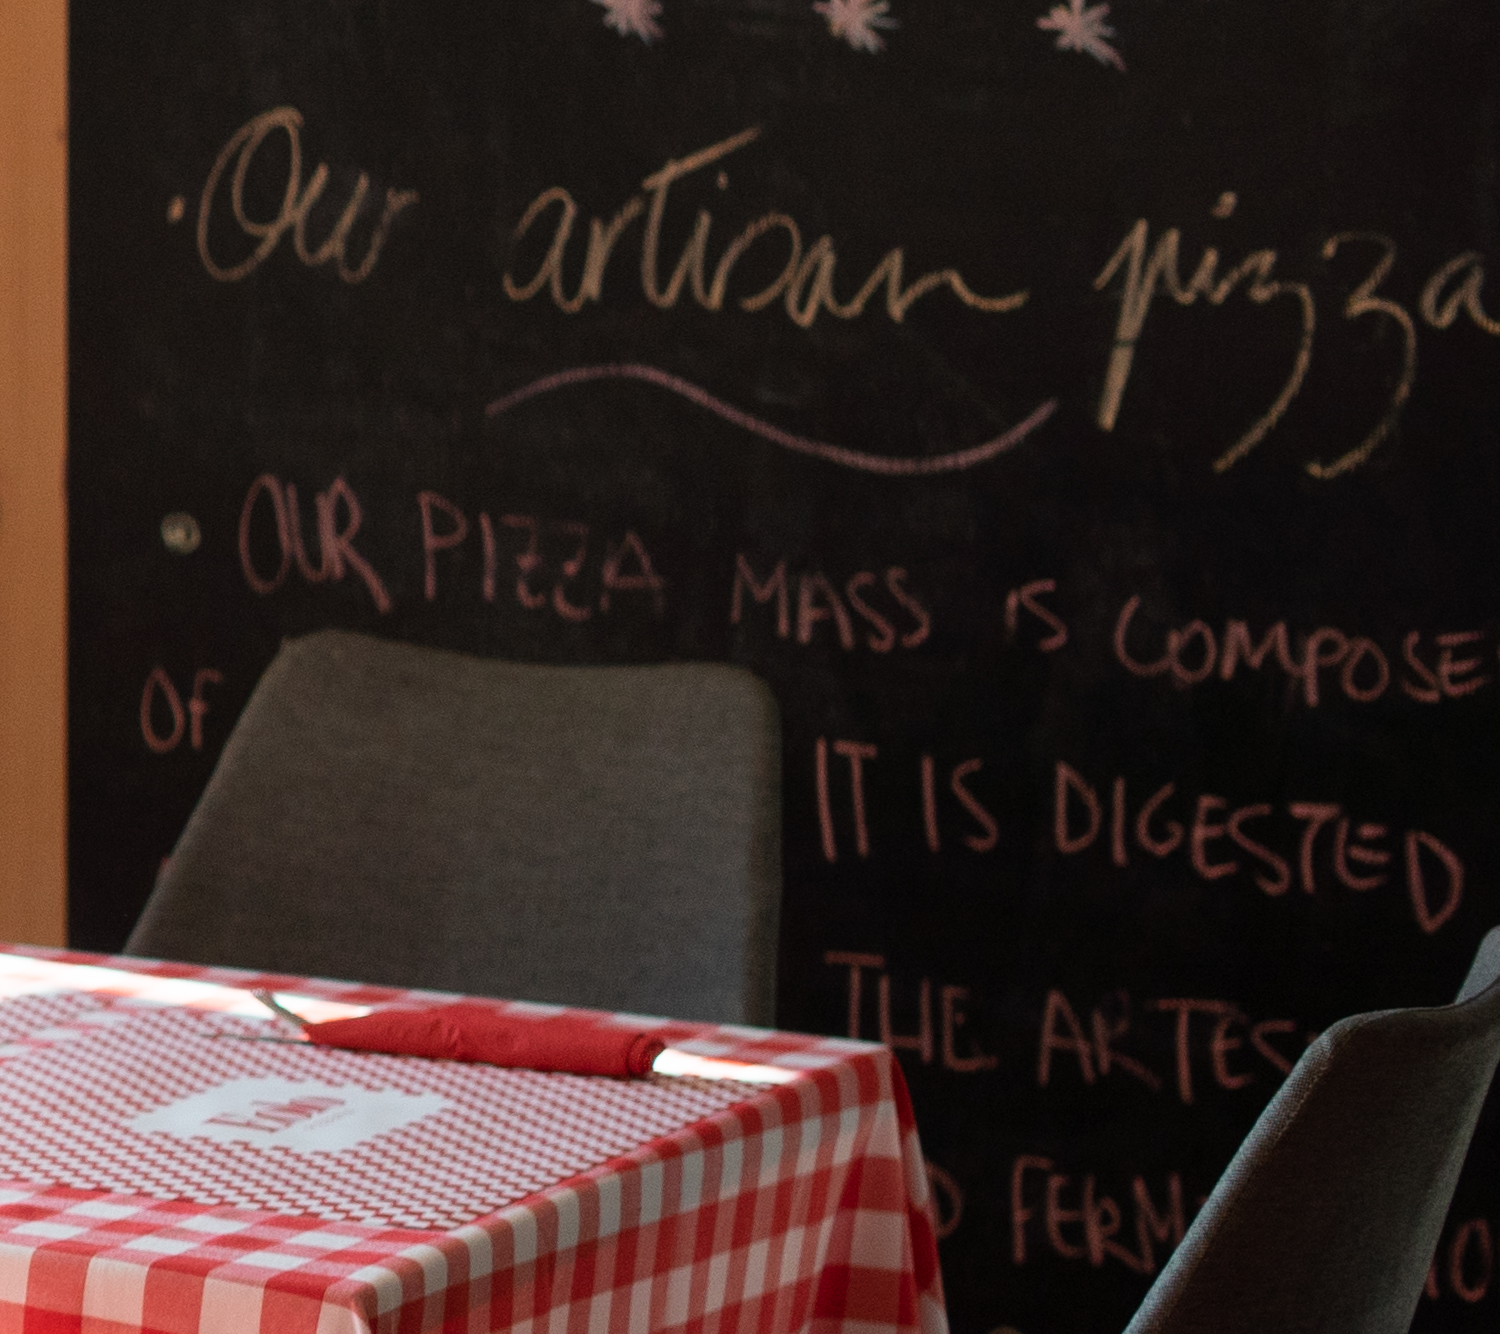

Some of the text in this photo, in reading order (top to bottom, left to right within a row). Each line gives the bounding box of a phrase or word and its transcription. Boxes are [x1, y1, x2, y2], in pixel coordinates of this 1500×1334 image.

[503, 125, 1031, 327] artisan
[238, 473, 1500, 707] OUR PIZZA MASS IS COMPOSE
[140, 667, 1465, 933] OF IT IS DIGESTED
[825, 950, 1322, 1105] THE ARTES
